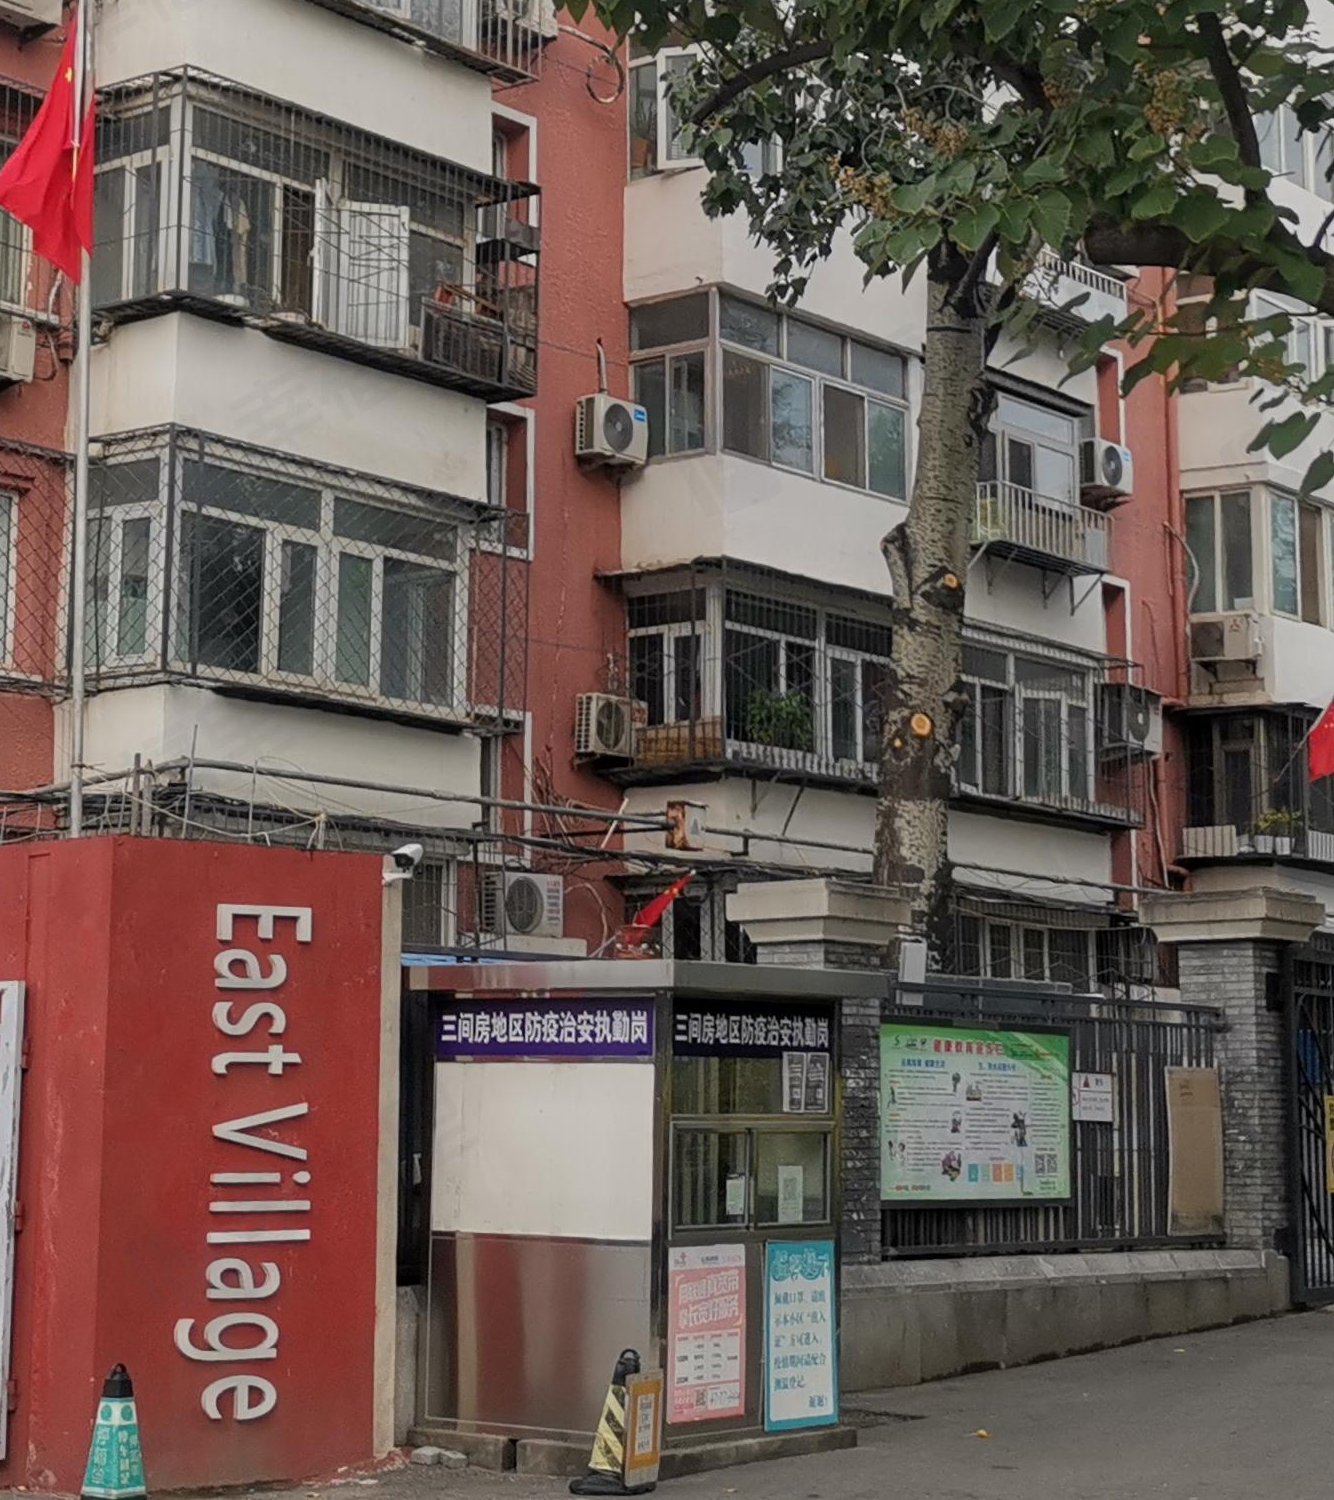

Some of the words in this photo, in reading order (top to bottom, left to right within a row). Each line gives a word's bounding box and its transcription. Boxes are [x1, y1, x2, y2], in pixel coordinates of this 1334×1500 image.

[211, 903, 312, 1075] East
[440, 1010, 648, 1045] 三间房地区防疫治安执勤岗
[674, 1012, 830, 1048] 三间房地区防疫治安执勤岗
[174, 1102, 311, 1420] Village
